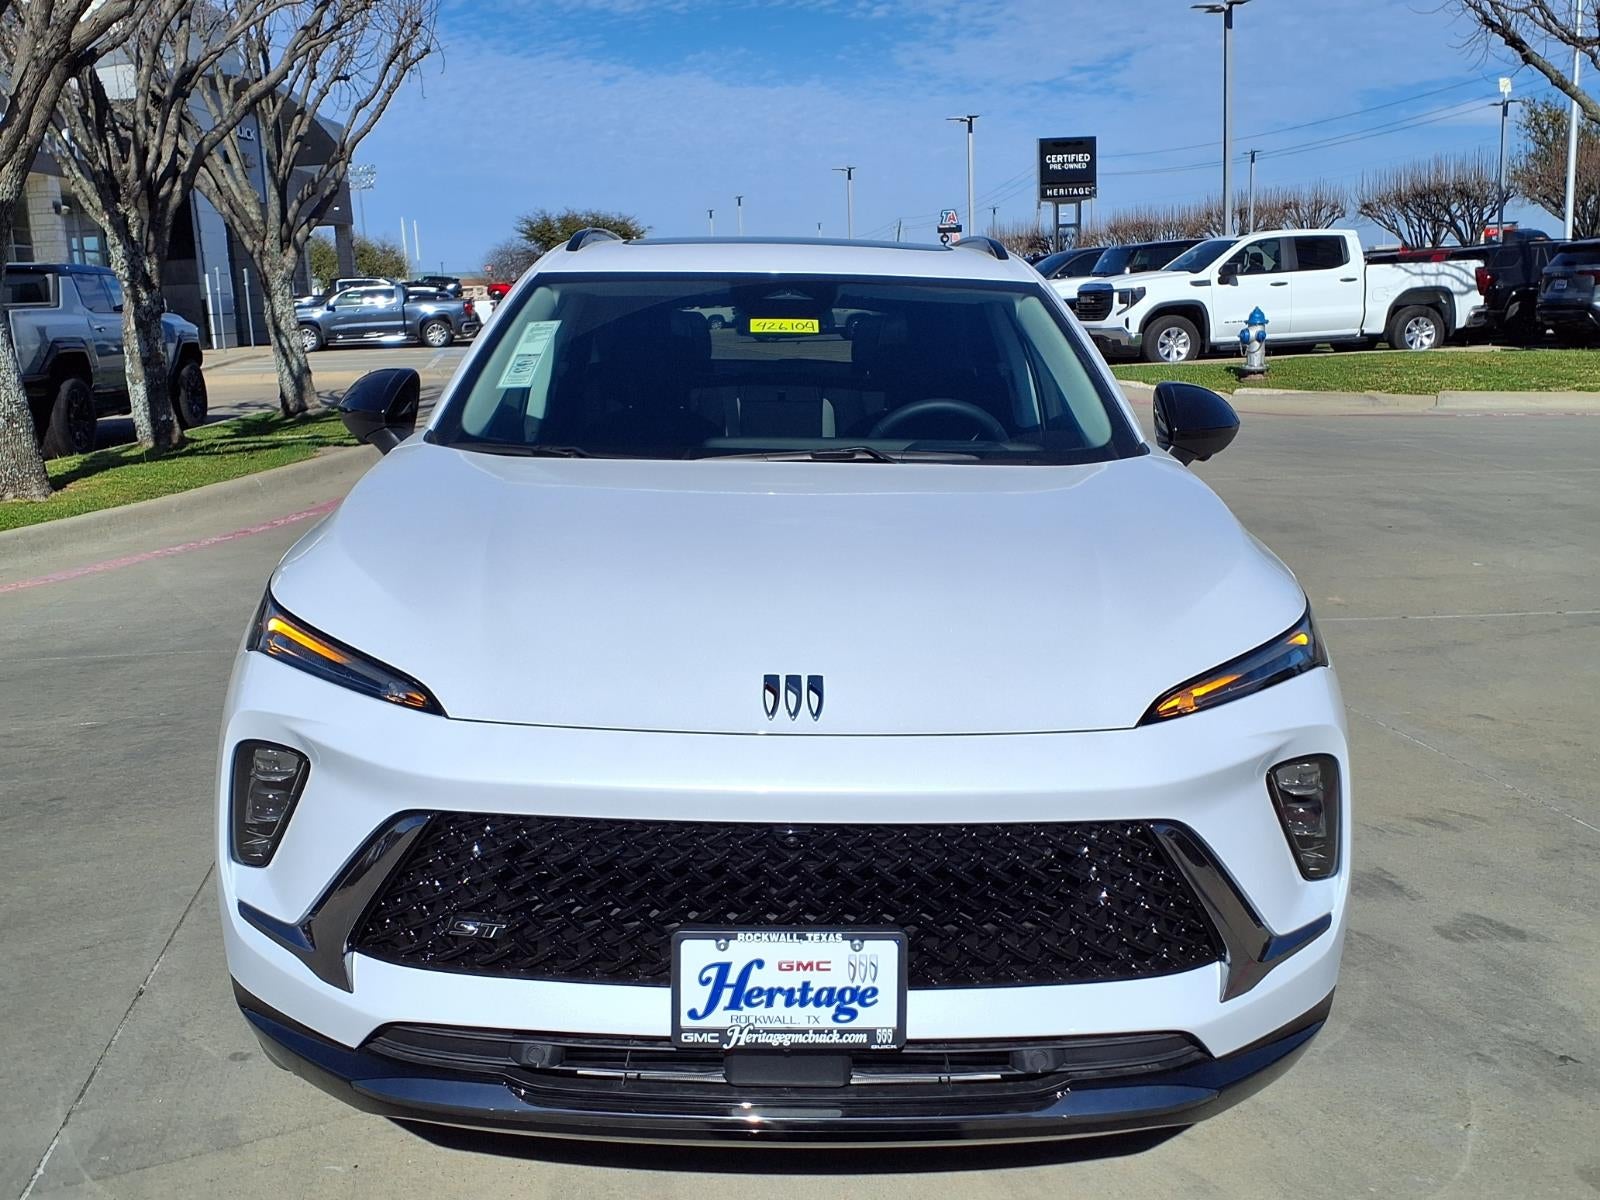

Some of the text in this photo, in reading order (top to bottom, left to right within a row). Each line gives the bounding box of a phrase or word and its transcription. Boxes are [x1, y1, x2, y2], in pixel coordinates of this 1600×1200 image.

[1045, 153, 1091, 163] CERTIFIED
[1049, 162, 1087, 170] PRE-OWNED
[1046, 186, 1092, 197] HERITAGE
[448, 920, 507, 939] ST
[737, 932, 843, 944] ROCKWALL, TEXAS
[777, 960, 832, 972] GMC
[687, 958, 879, 1024] Heritage
[806, 1015, 821, 1025] TX
[681, 1023, 868, 1049] GMC Heritagegmcbuick.com
